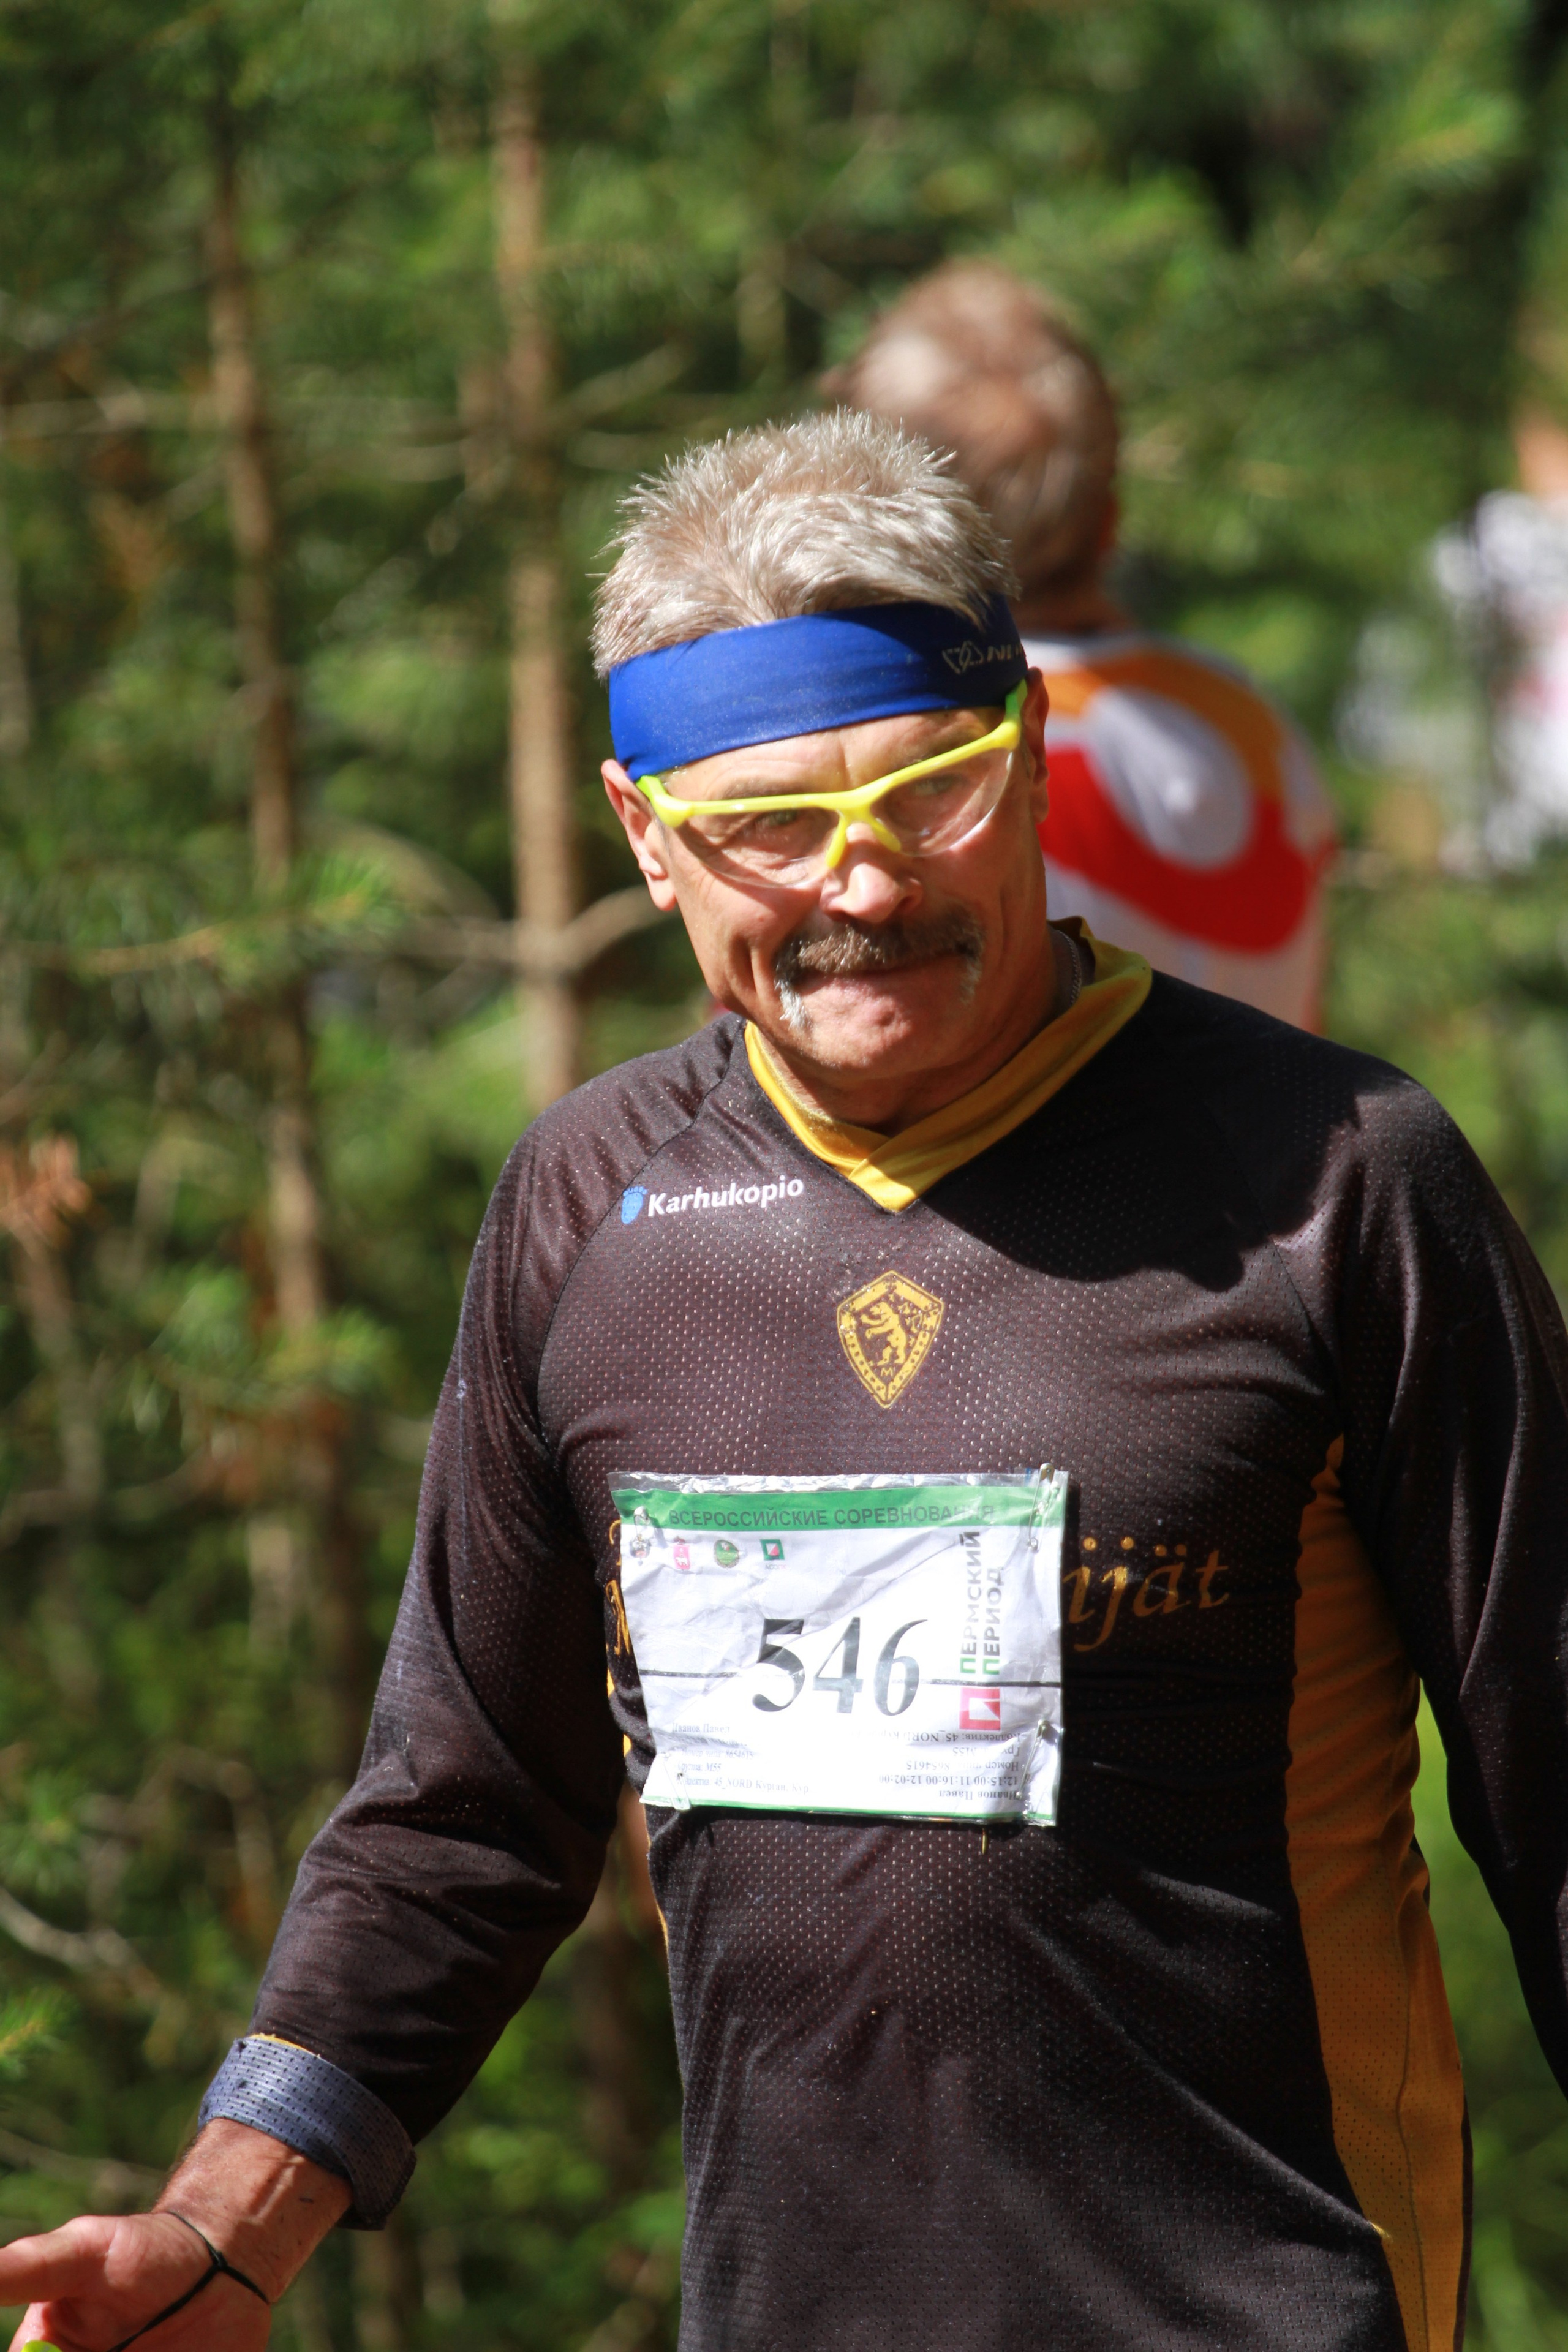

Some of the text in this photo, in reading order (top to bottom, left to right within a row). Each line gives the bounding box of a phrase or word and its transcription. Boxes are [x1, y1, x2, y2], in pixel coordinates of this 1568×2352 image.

[647, 1175, 804, 1216] Karhukopio
[669, 1505, 994, 1526] ВСЕРОССИЙСКИЕ СОРЕВНОВАНИЯ
[959, 1531, 981, 1674] ПЕРМСКИЙ
[982, 1566, 1004, 1675] ПЕРИОД
[752, 1616, 928, 1716] 546
[878, 1774, 1018, 1787] 12:15:00 11:16:00 12:02:00
[986, 1761, 1019, 1771] Номер
[939, 1790, 1017, 1800] Иванов Павел
